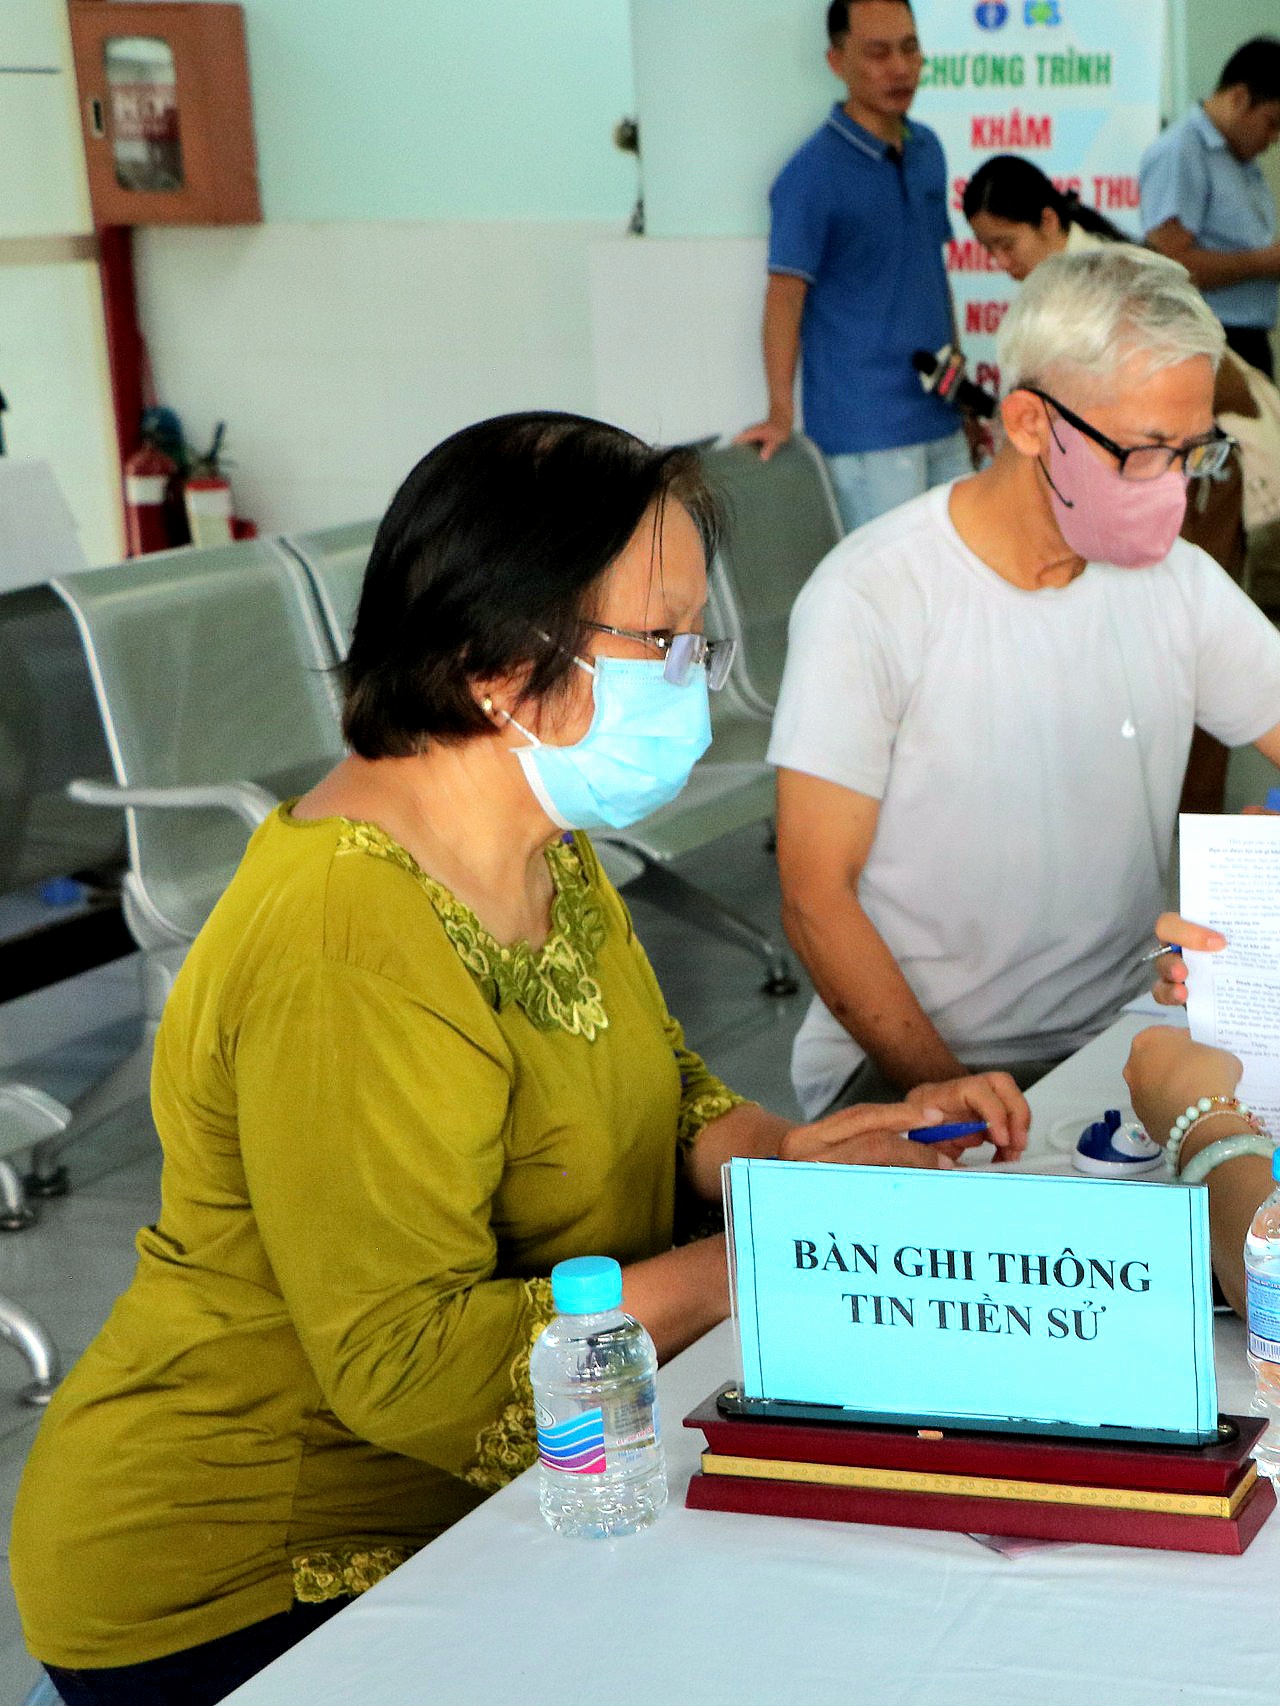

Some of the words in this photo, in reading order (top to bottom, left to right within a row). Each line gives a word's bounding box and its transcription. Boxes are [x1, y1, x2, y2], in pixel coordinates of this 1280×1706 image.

[1036, 46, 1112, 87] TRÌNH
[971, 107, 1052, 149] KHÁM
[794, 1232, 879, 1275] BÀN
[894, 1246, 974, 1281] GHI
[988, 1247, 1151, 1293] THÔNG
[842, 1293, 914, 1328] TIN
[928, 1292, 1031, 1336] TIỀN
[1047, 1300, 1107, 1341] SỬ
